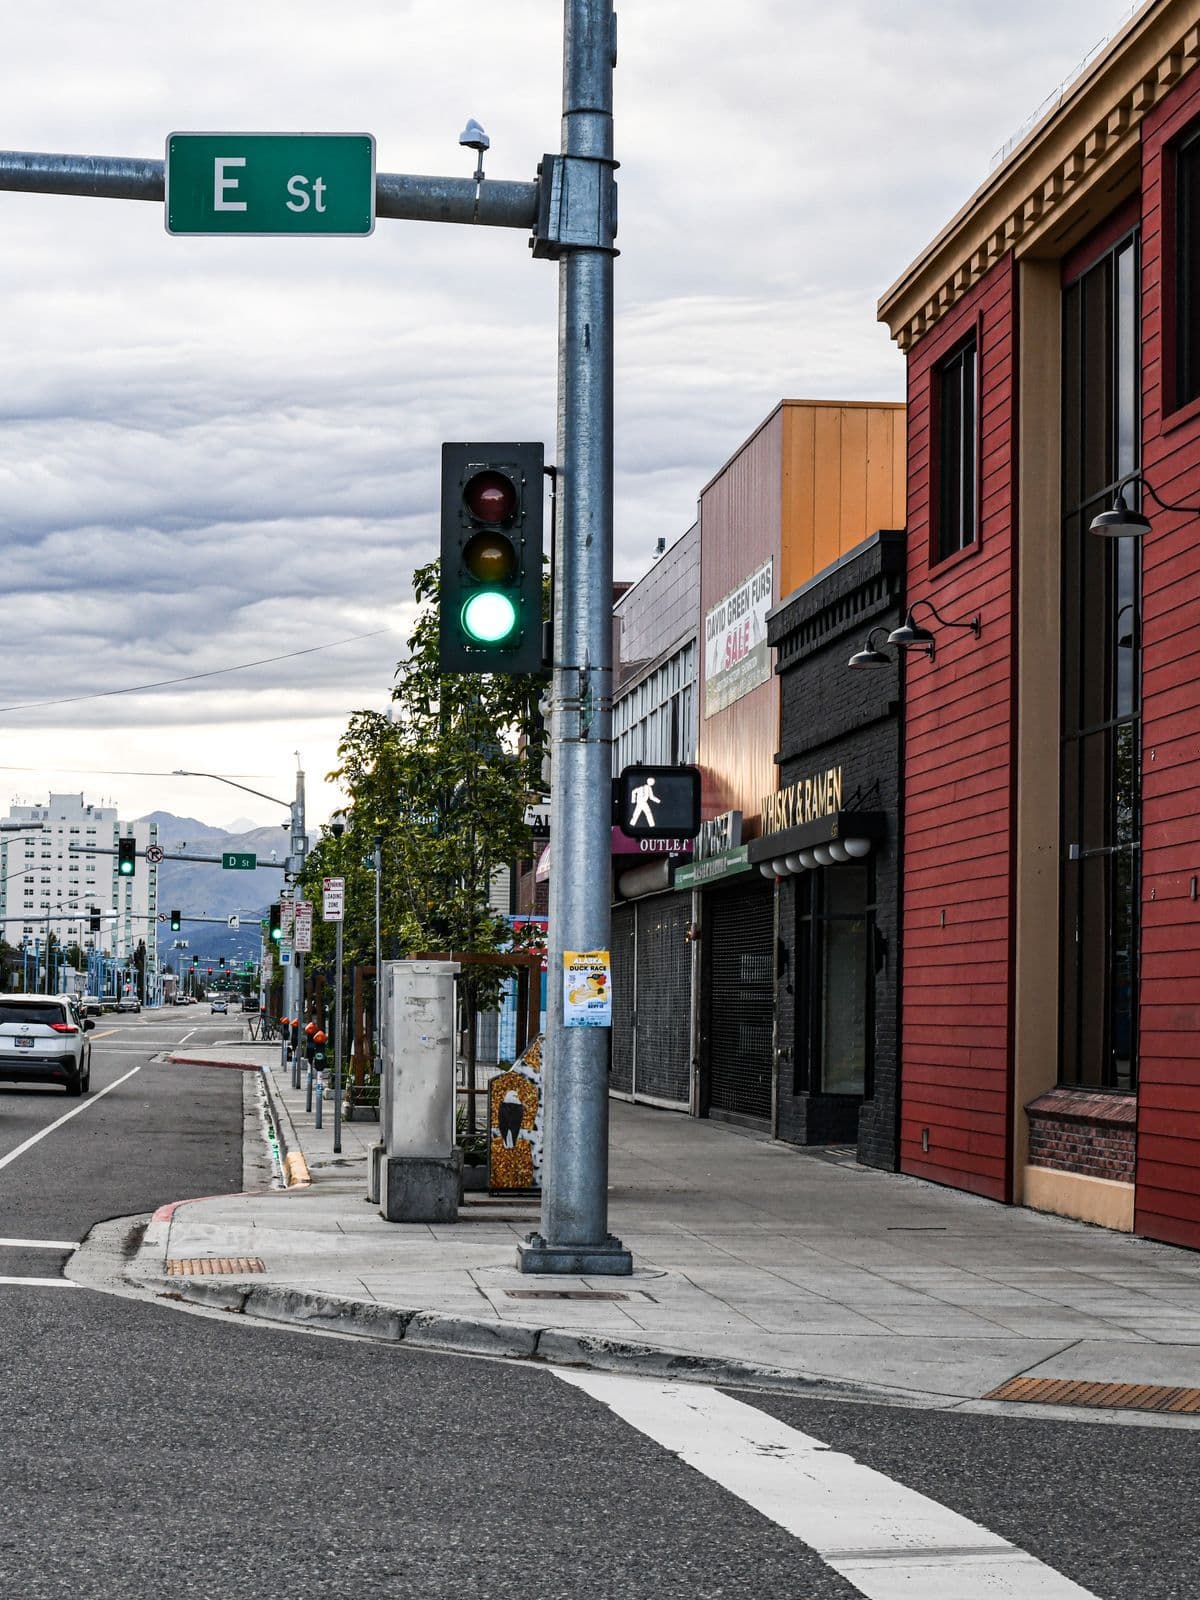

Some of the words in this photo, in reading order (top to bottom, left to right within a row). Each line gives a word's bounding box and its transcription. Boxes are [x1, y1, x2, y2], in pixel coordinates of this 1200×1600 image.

[213, 156, 247, 211] E
[286, 174, 327, 214] St
[706, 607, 726, 642] DAVID
[727, 586, 750, 624] GREEN
[751, 566, 771, 607] FURS
[725, 621, 750, 670] SALE
[760, 784, 795, 837] WHISKY
[795, 781, 803, 825] &
[804, 765, 843, 823] RAMEN
[230, 856, 236, 866] D
[640, 838, 689, 851] OUTLET
